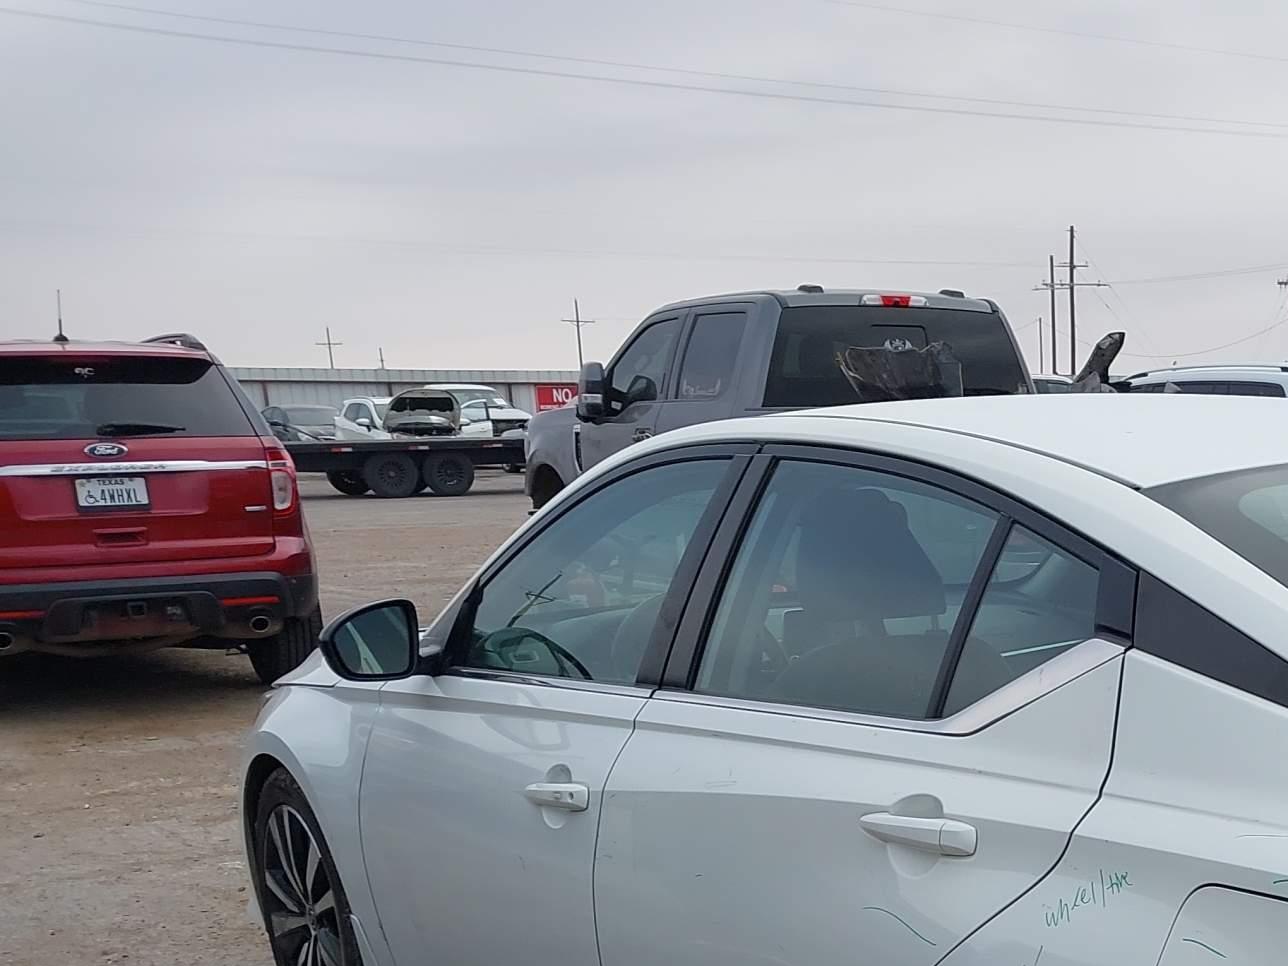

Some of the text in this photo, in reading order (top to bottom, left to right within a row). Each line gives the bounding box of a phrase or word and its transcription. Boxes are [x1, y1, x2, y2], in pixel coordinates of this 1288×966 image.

[552, 388, 572, 403] NO
[93, 444, 119, 455] Ford
[100, 487, 142, 503] 4WHXL
